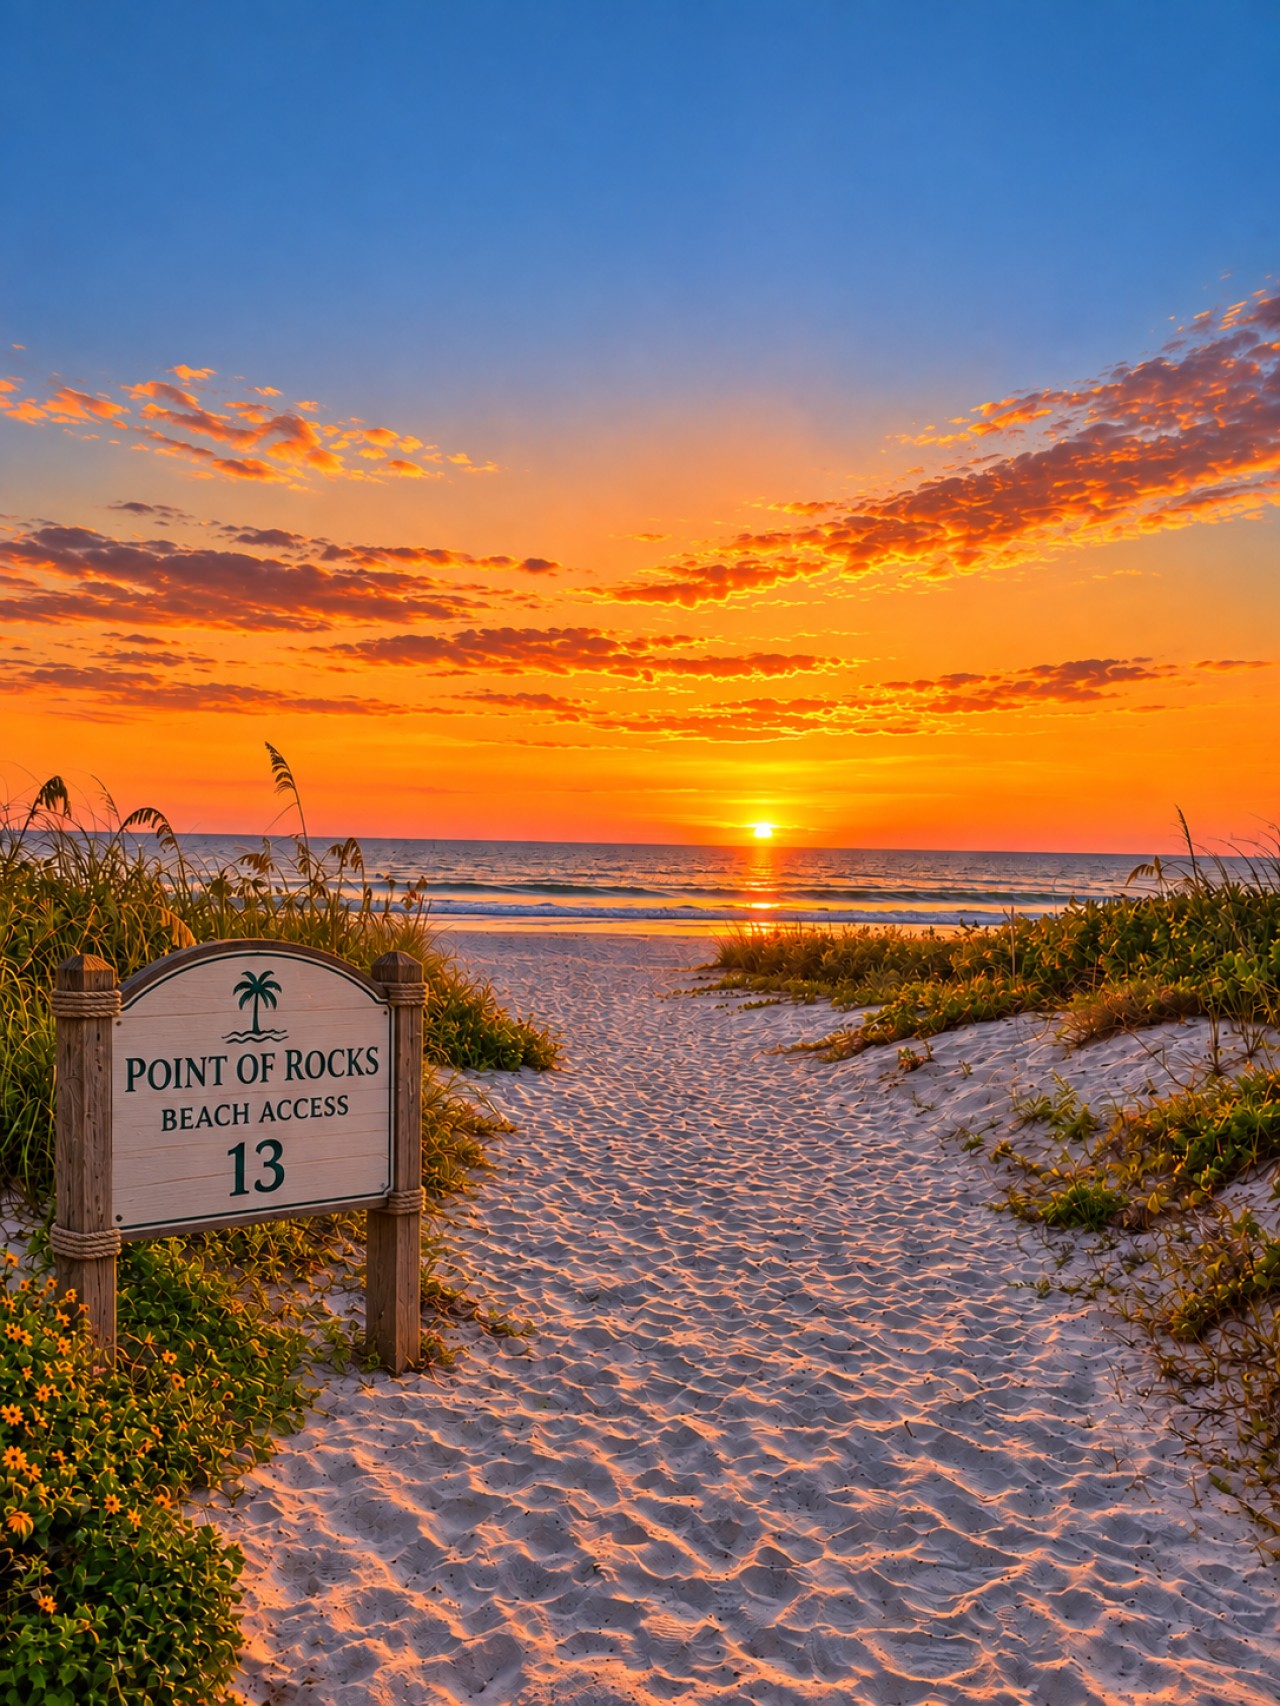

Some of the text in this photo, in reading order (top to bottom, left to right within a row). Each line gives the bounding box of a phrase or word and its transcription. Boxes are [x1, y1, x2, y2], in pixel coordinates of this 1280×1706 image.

[124, 1046, 380, 1093] POINT OF ROCKS
[160, 1094, 349, 1132] BEACH ACCESS
[226, 1138, 286, 1198] 13
